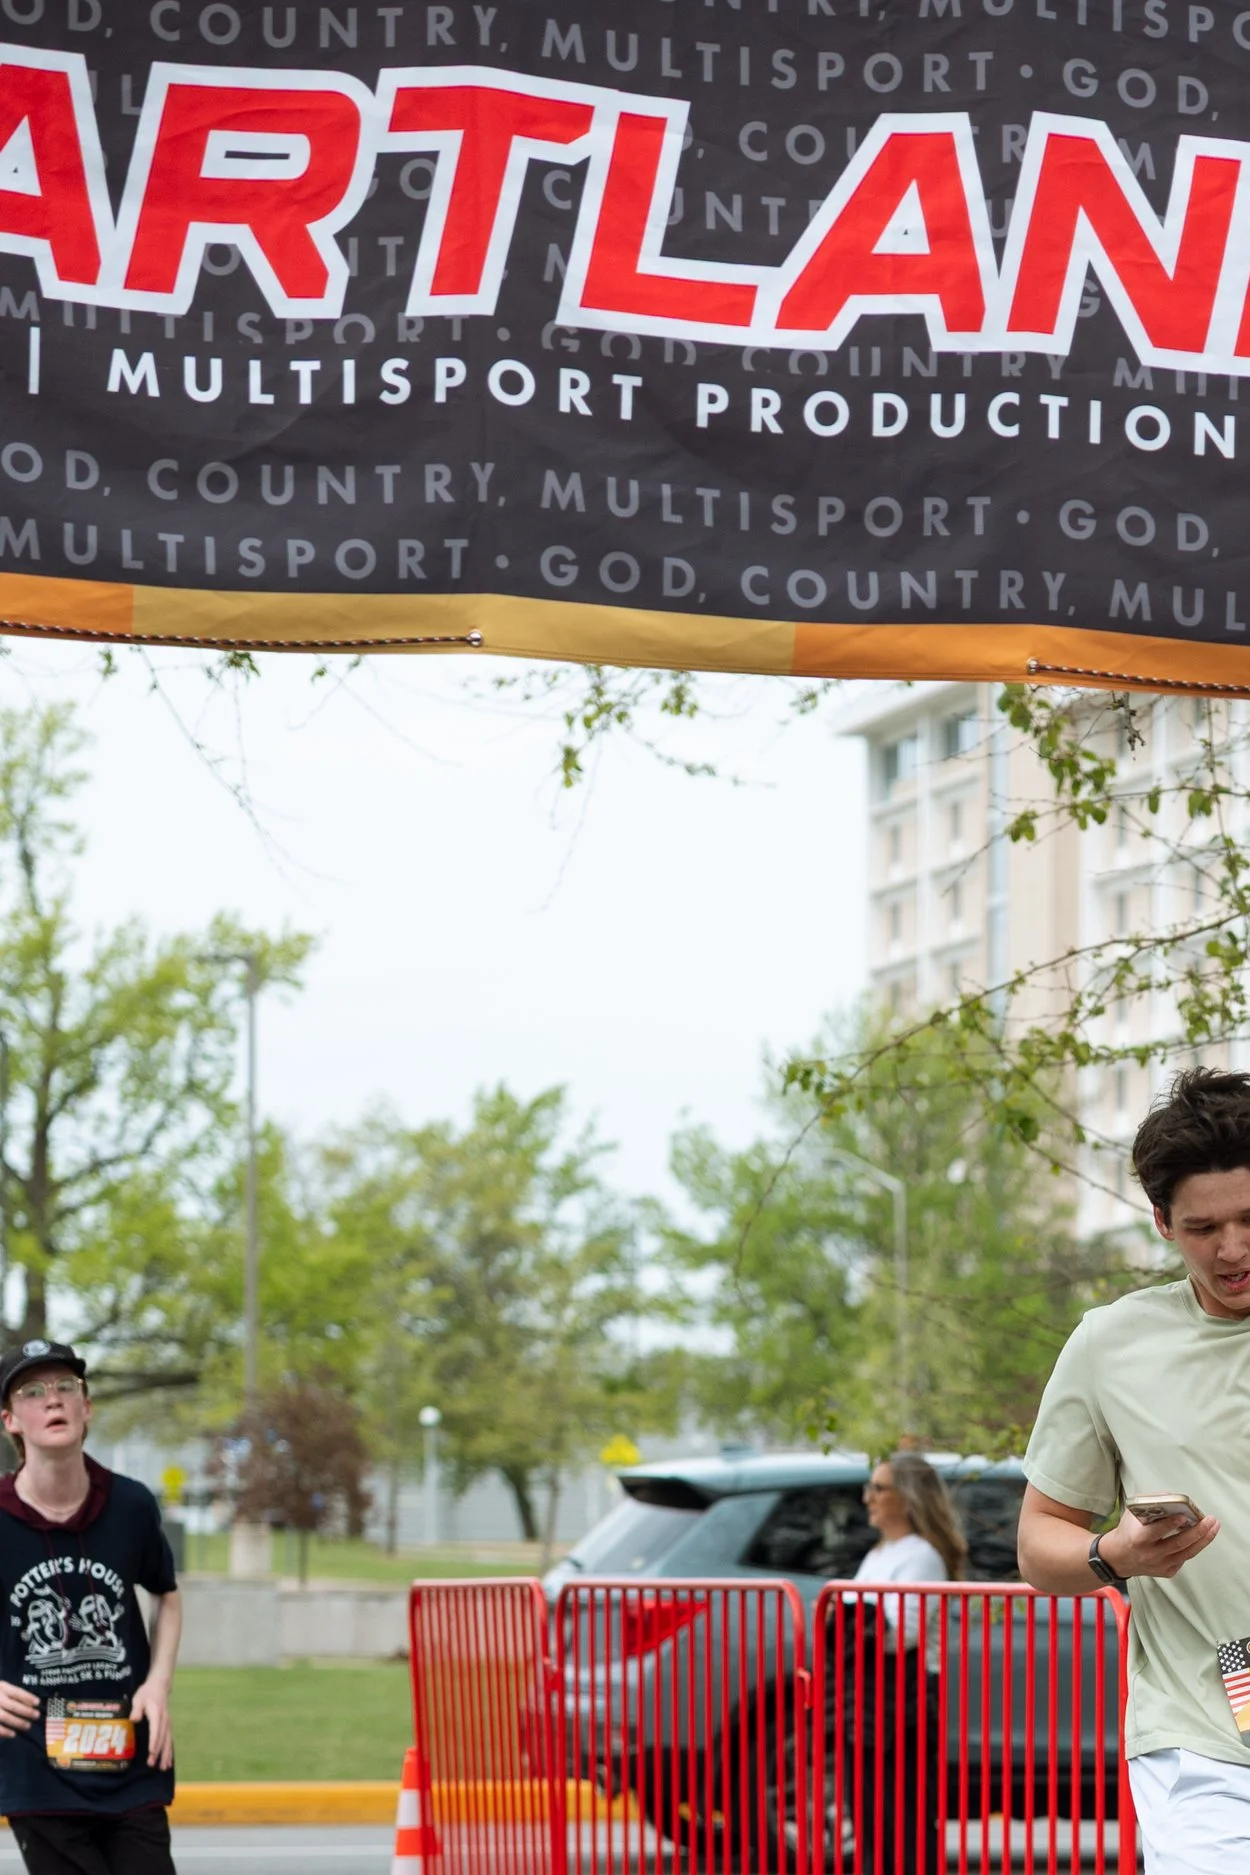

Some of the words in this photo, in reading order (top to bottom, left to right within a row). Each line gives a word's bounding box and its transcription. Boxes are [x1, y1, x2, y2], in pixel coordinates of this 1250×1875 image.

[150, 0, 507, 53] COUNTRY,
[541, 19, 993, 93] MULTISPORT
[1063, 58, 1219, 121] GOD,
[107, 347, 643, 421] MULTISPORT
[147, 458, 505, 507] COUNTRY,
[541, 469, 992, 538] MULTISPORT
[1059, 499, 1220, 558] GOD,
[0, 515, 469, 580] MULTISPORT
[540, 544, 706, 603] GOD,
[740, 564, 1077, 616] COUNTRY,
[9, 1556, 75, 1608] POTTER'S
[63, 1723, 127, 1756] 2024
